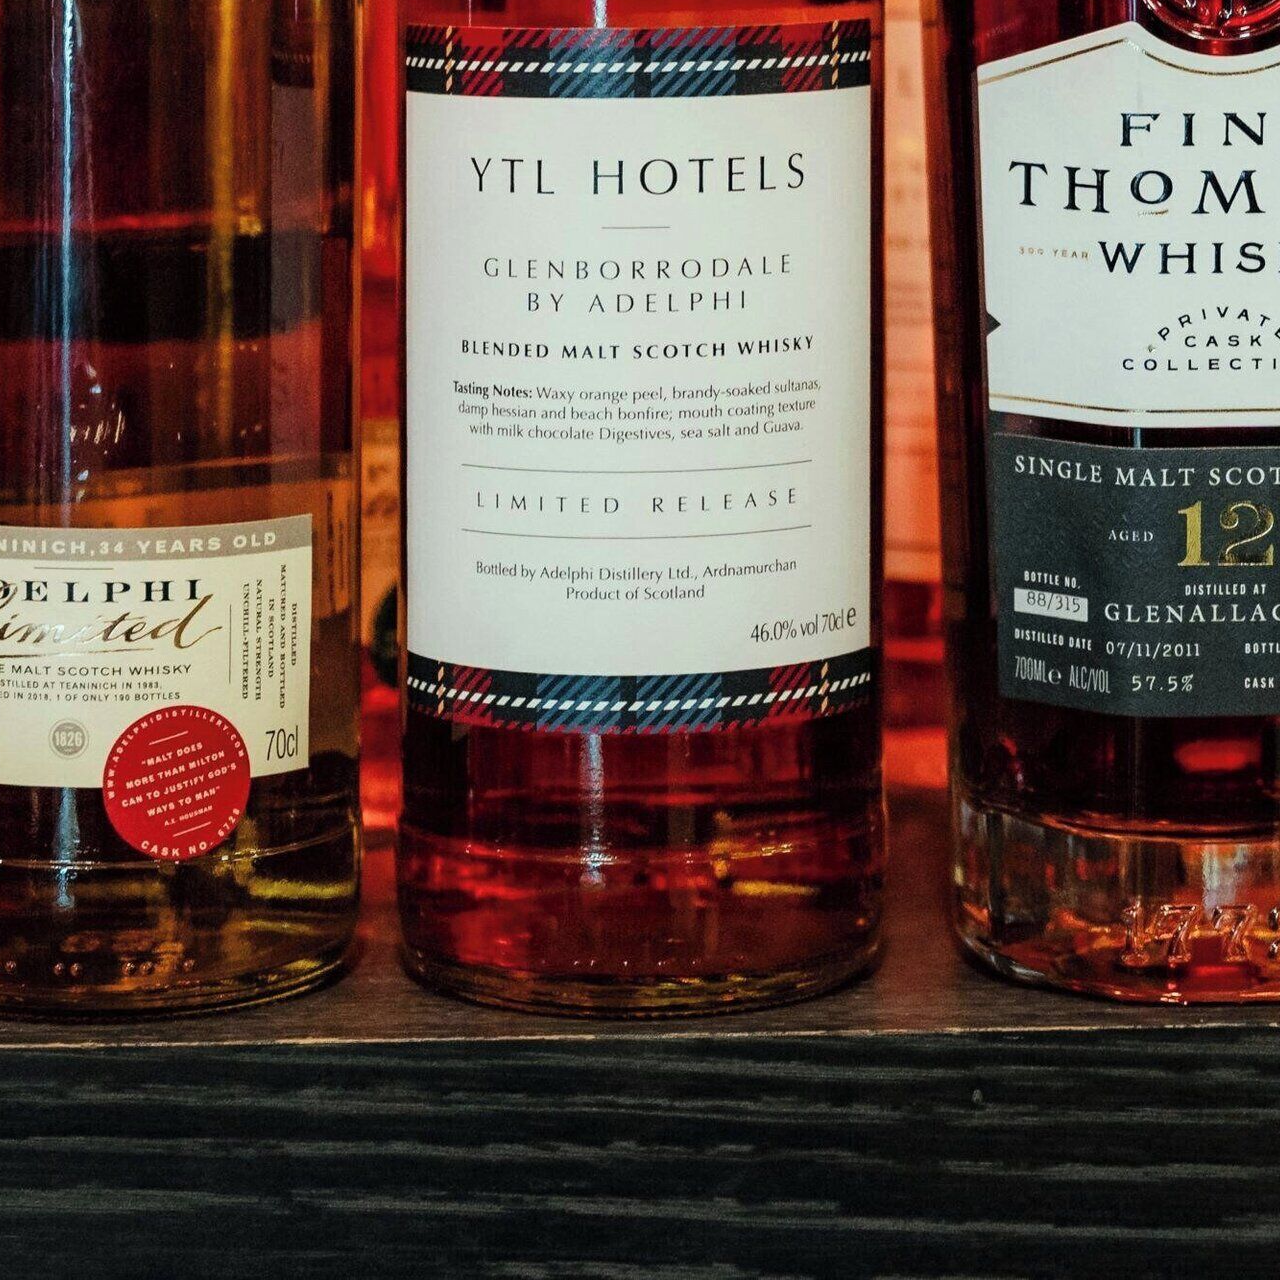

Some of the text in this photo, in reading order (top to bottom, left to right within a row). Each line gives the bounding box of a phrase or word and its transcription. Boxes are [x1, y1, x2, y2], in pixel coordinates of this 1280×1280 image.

[471, 153, 803, 194] YTL HOTELS
[1053, 249, 1088, 260] YEAR
[484, 254, 789, 279] GLENBORRODALE
[528, 291, 744, 312] BY ADELPHI
[462, 336, 812, 358] BLENDED MALT SCOTCH WHISKY
[1185, 335, 1261, 347] CASK
[453, 379, 820, 404] Tasting Notes: Waxy orange peel, brandy-soaked sultanas,
[459, 400, 815, 420] damp hessian and beach bonfire; mouth coating texture
[470, 421, 803, 443] with milk chocolate Digestives, sea salt and Guava.
[1015, 455, 1101, 483] SINGLE
[1115, 468, 1194, 486] MALT
[478, 488, 795, 513] LIMITED RELEASE
[137, 533, 222, 555] YEARS
[233, 532, 275, 548] OLD
[1109, 530, 1153, 541] AGED
[1178, 500, 1274, 566] 12
[1024, 571, 1080, 589] BOTTLE NO.
[1185, 584, 1266, 596] DISTILLED AT
[567, 585, 704, 600] Product of Scotland
[1026, 591, 1081, 613] 88/315
[751, 620, 797, 642] 46.0%
[800, 618, 819, 638] vol
[1015, 628, 1199, 659] DISTILLED DATE 07/11/2011
[12, 665, 51, 675] MALT
[58, 667, 121, 676] SCOTCH
[128, 661, 192, 676] WHISKY
[1069, 665, 1110, 693] ALC/VOL
[1132, 674, 1193, 692] 57.5%
[1245, 677, 1274, 688] CASK
[54, 729, 83, 748] 1826
[266, 725, 298, 760] 70cl
